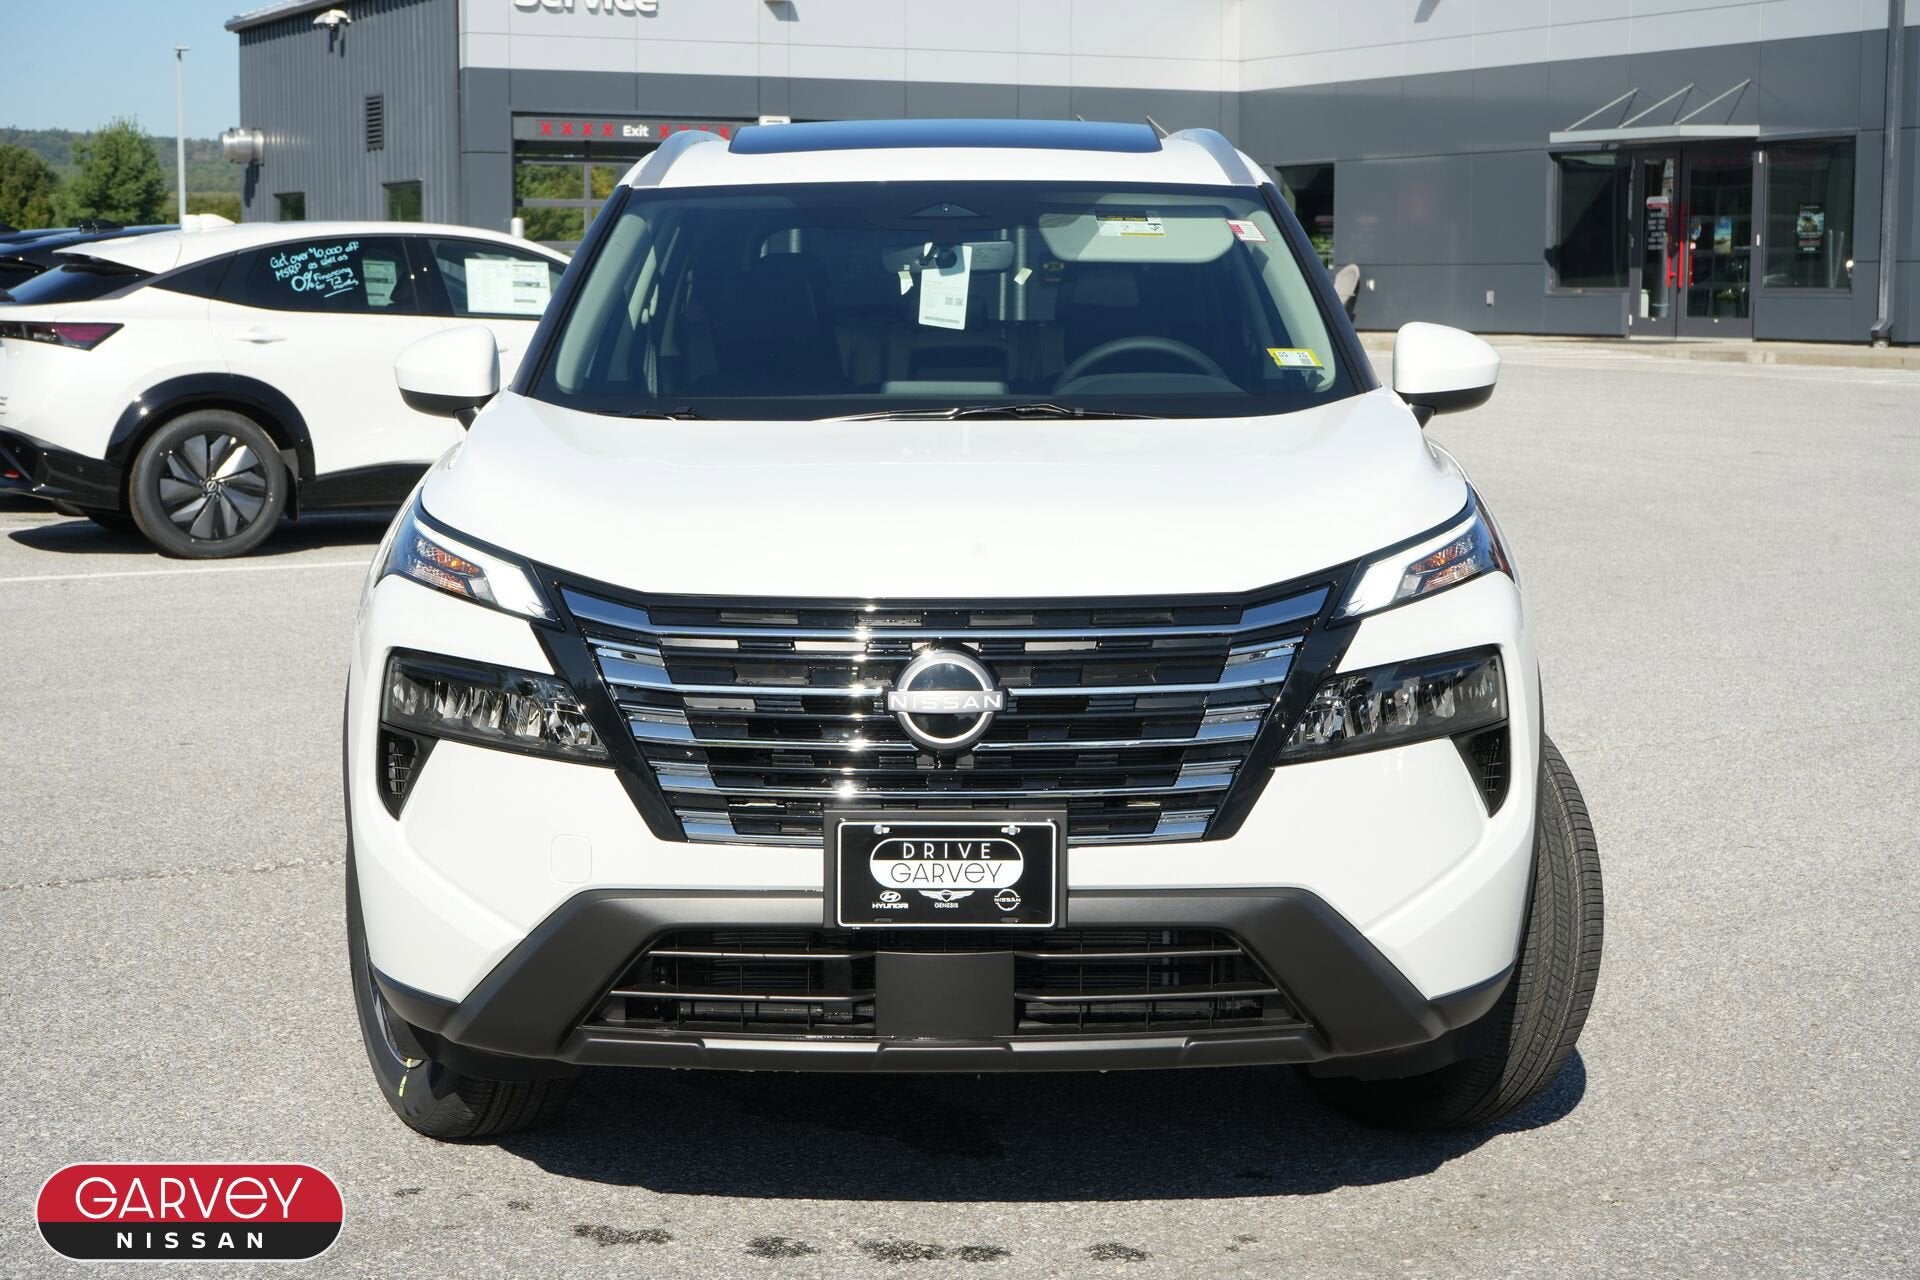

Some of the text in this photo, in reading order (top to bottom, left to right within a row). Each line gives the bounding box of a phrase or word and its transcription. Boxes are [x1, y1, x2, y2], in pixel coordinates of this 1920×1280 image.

[622, 124, 649, 137] Exit
[270, 252, 289, 269] Get
[290, 252, 308, 264] over
[275, 262, 302, 281] MSRP
[291, 270, 315, 292] 0%
[890, 695, 1001, 709] NISSAN
[903, 843, 991, 859] DRIVE
